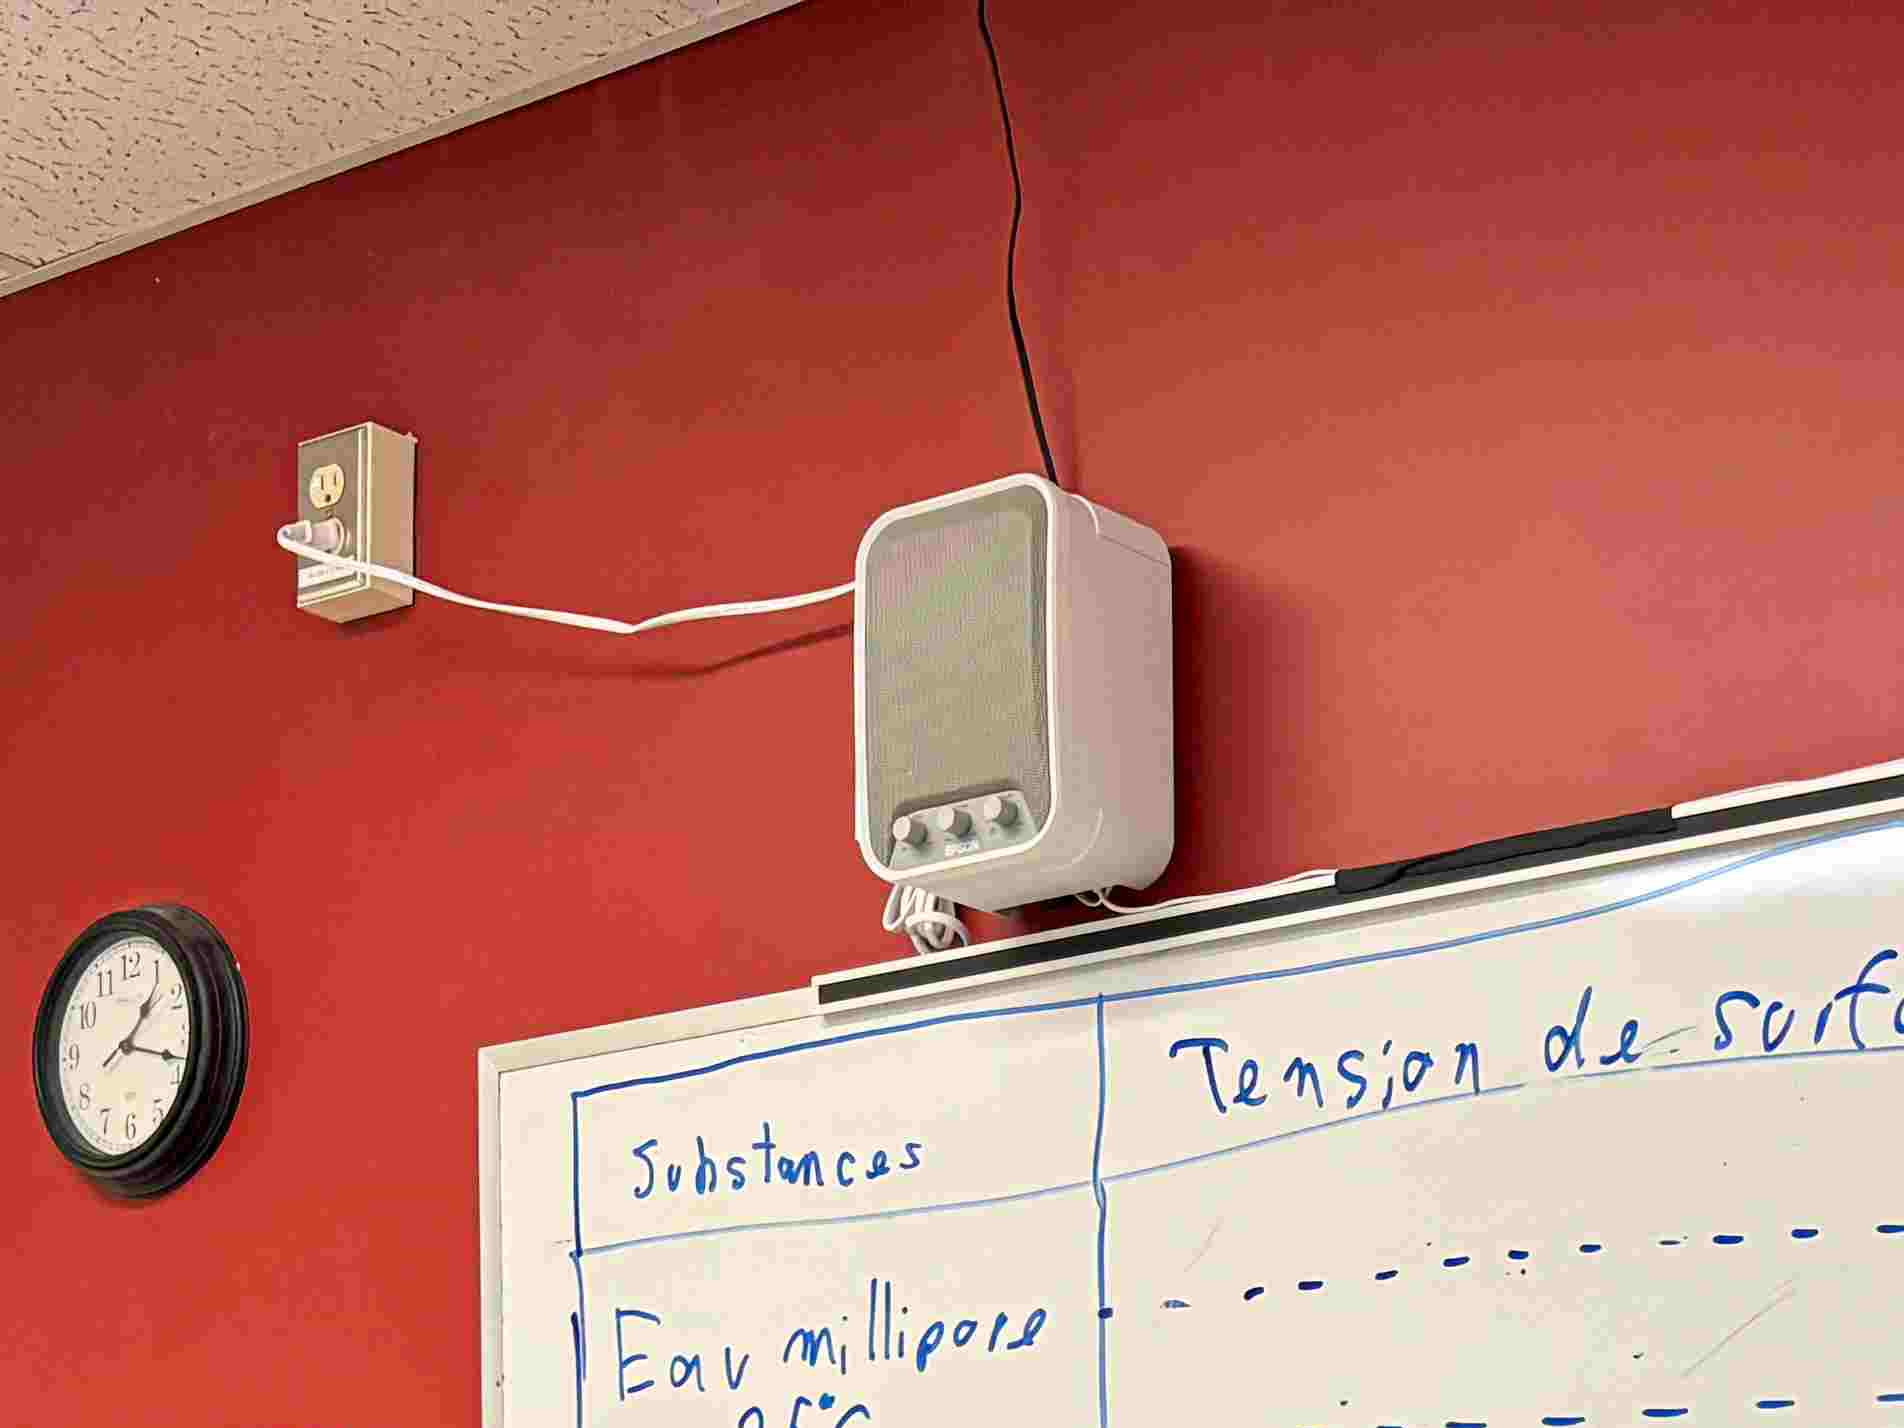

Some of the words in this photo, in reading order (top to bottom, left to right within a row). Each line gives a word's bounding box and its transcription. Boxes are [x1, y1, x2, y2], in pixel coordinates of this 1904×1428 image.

[121, 951, 142, 981] 12
[96, 969, 114, 998] 11
[79, 1001, 97, 1030] 10
[68, 1044, 80, 1072] 9
[1169, 1036, 1481, 1115] Tension
[1544, 986, 1642, 1072] de
[79, 1083, 91, 1111] 8
[99, 1108, 113, 1135] 7
[125, 1113, 137, 1140] 6
[631, 1130, 926, 1202] Substances
[783, 1277, 1047, 1374] millipore
